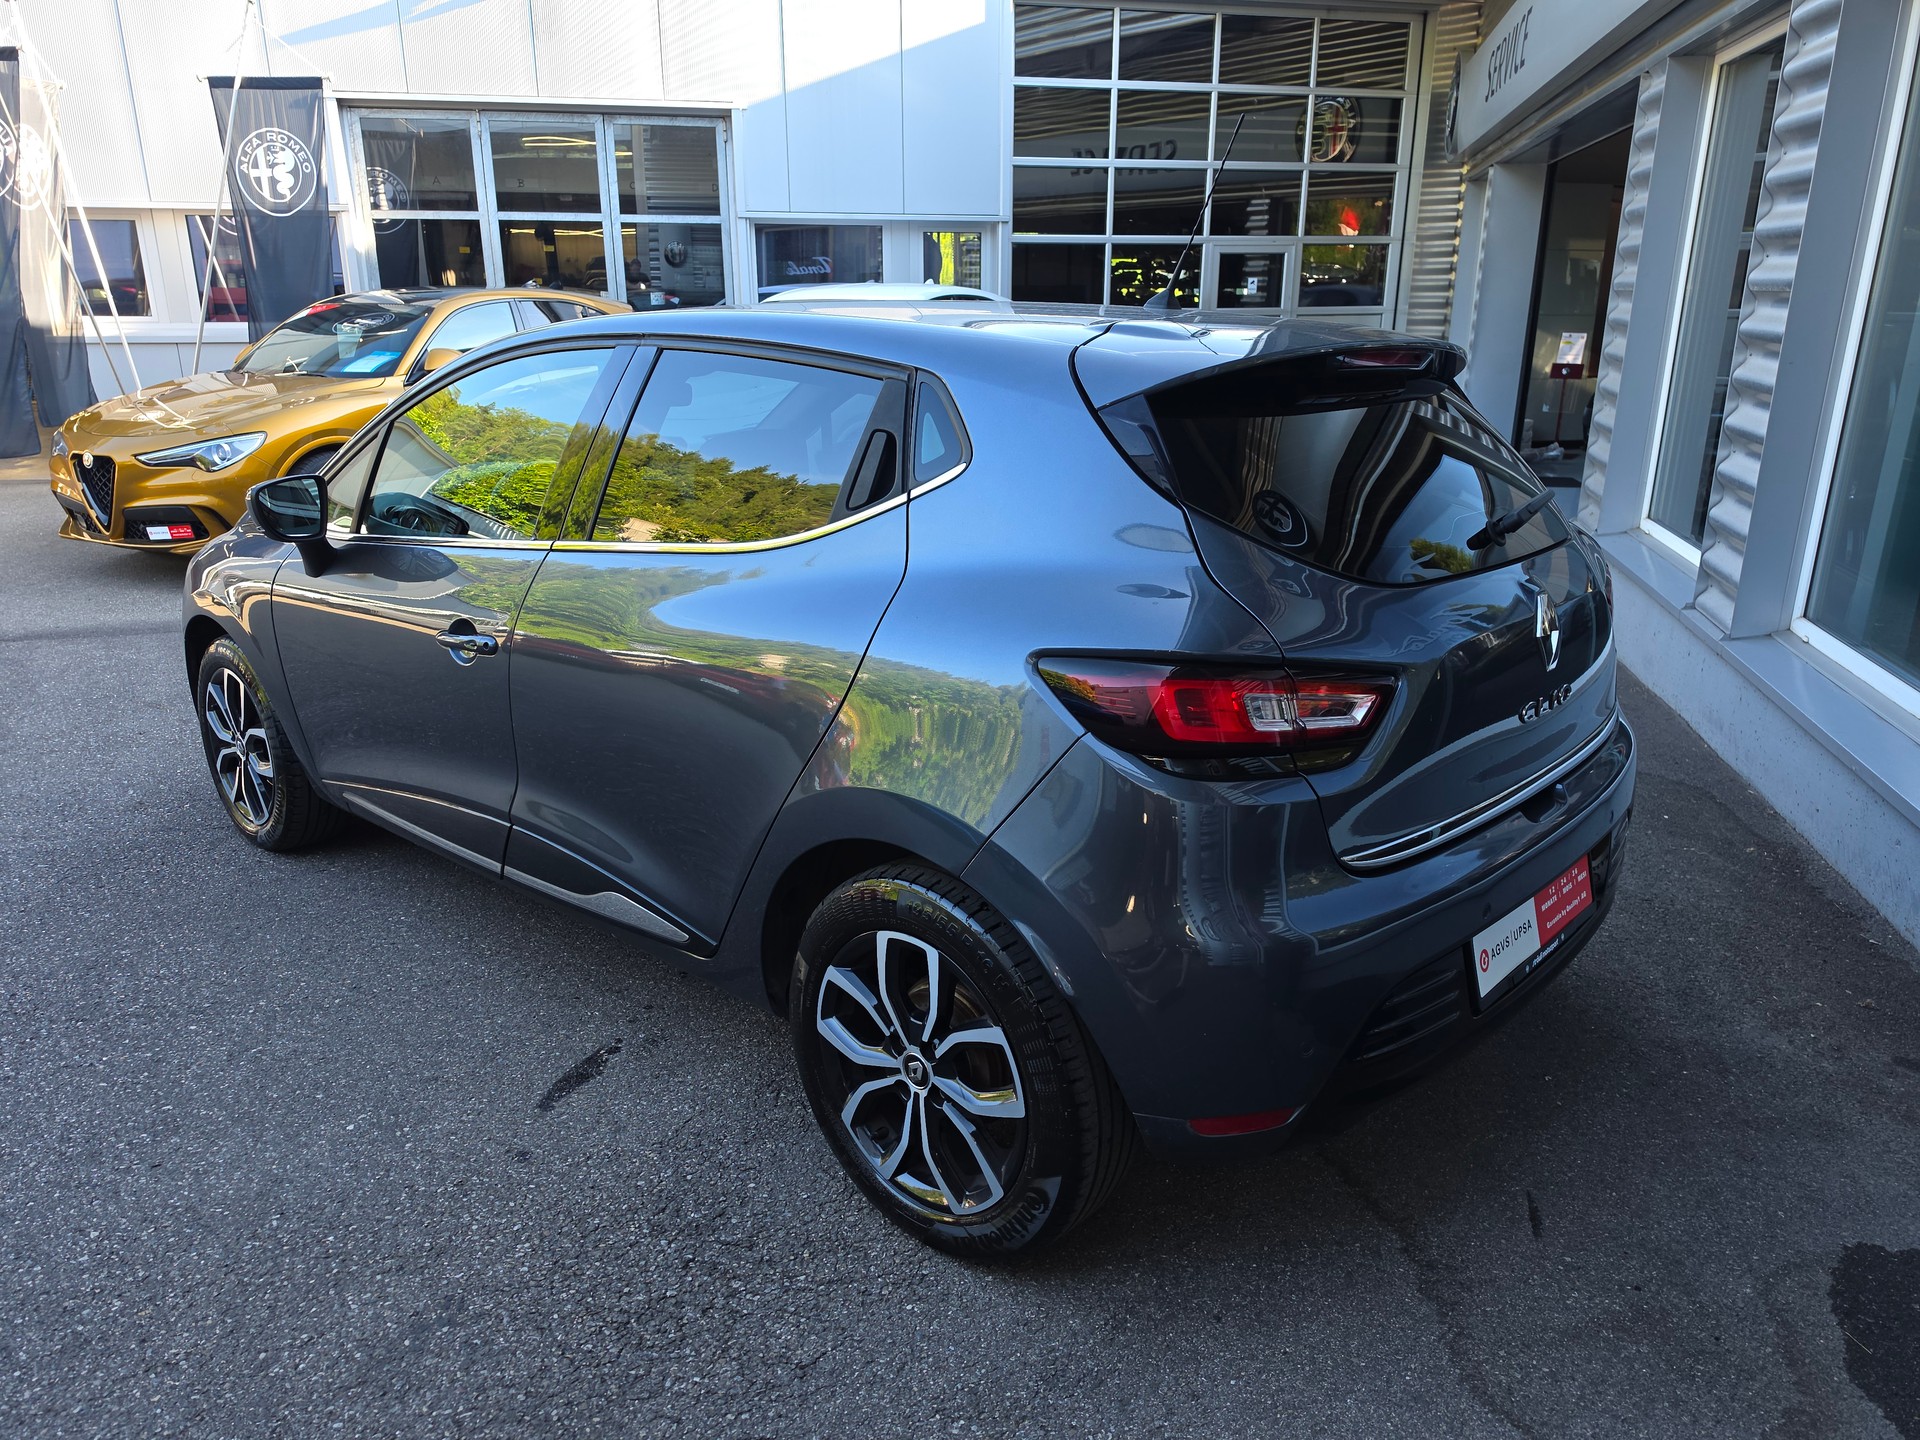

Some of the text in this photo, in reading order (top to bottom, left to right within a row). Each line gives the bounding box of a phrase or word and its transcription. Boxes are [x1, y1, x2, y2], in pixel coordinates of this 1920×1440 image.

[1485, 6, 1533, 103] SERVICE
[239, 132, 311, 174] ALFA ROMEO
[432, 176, 441, 185] A
[517, 178, 525, 187] B
[1518, 683, 1572, 725] CLIO
